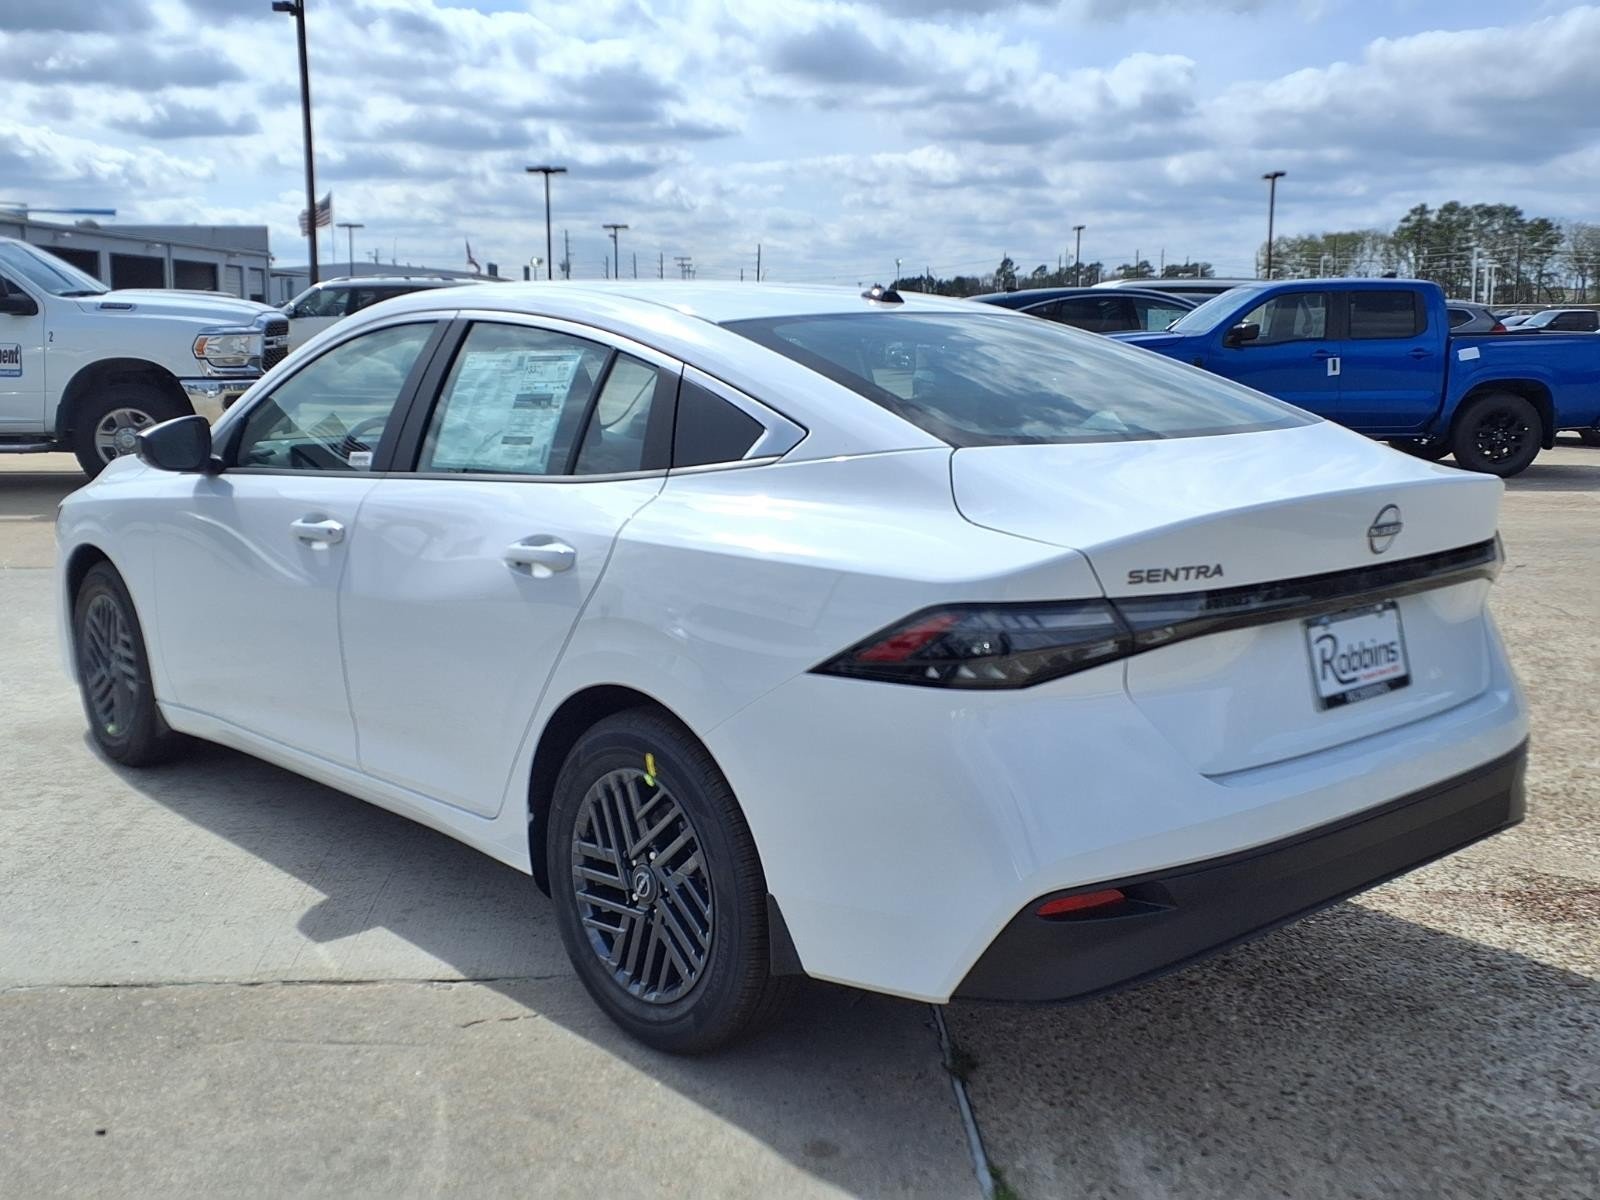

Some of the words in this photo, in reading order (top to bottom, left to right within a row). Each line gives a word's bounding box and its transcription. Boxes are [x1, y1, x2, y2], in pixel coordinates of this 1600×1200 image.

[49, 330, 54, 343] 2
[1127, 563, 1224, 585] SENTRA
[1314, 633, 1399, 685] Robbins
